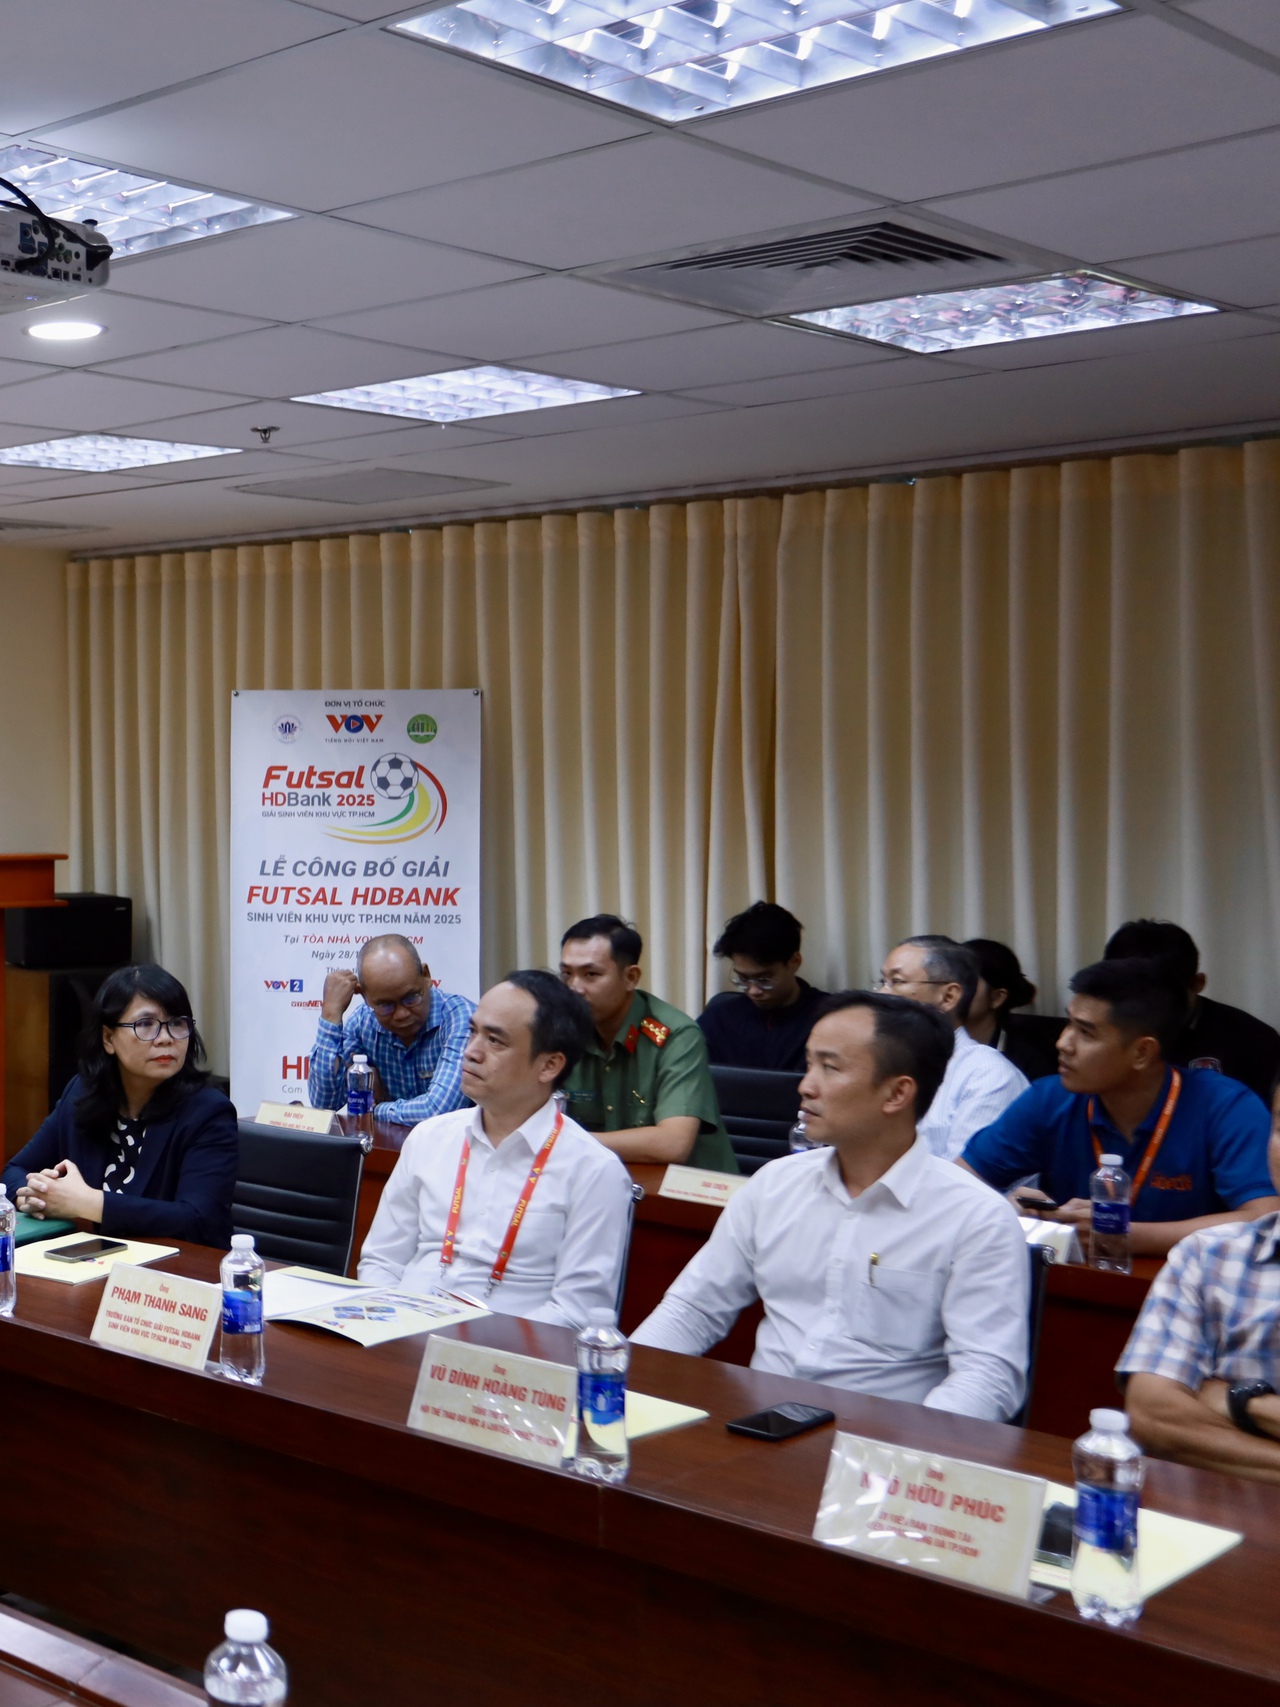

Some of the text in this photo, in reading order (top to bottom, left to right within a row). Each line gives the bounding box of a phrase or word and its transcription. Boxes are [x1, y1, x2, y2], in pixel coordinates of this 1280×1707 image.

[326, 714, 383, 734] VOV
[262, 765, 365, 789] Futsal
[261, 792, 375, 806] HDBank 2025
[259, 855, 450, 877] LỄ CÔNG BỐ GIẢI
[246, 885, 461, 906] FUTSAL HDBANK
[246, 910, 461, 925] SINH VIÊN KHU VỰC TP.HCM NĂM 2025
[284, 934, 350, 944] Tại TÒA NHÀ
[311, 950, 335, 961] Ngày
[264, 980, 289, 990] VOV
[511, 1199, 527, 1226] FUTSAL
[111, 1286, 141, 1304] PHẠM
[143, 1294, 177, 1313] THANH
[178, 1303, 208, 1321] SANG
[430, 1364, 567, 1412] VŨ ĐÌNH HOÀNG TÙNG
[860, 1471, 1005, 1522] NÔ HỮU PHÚC
